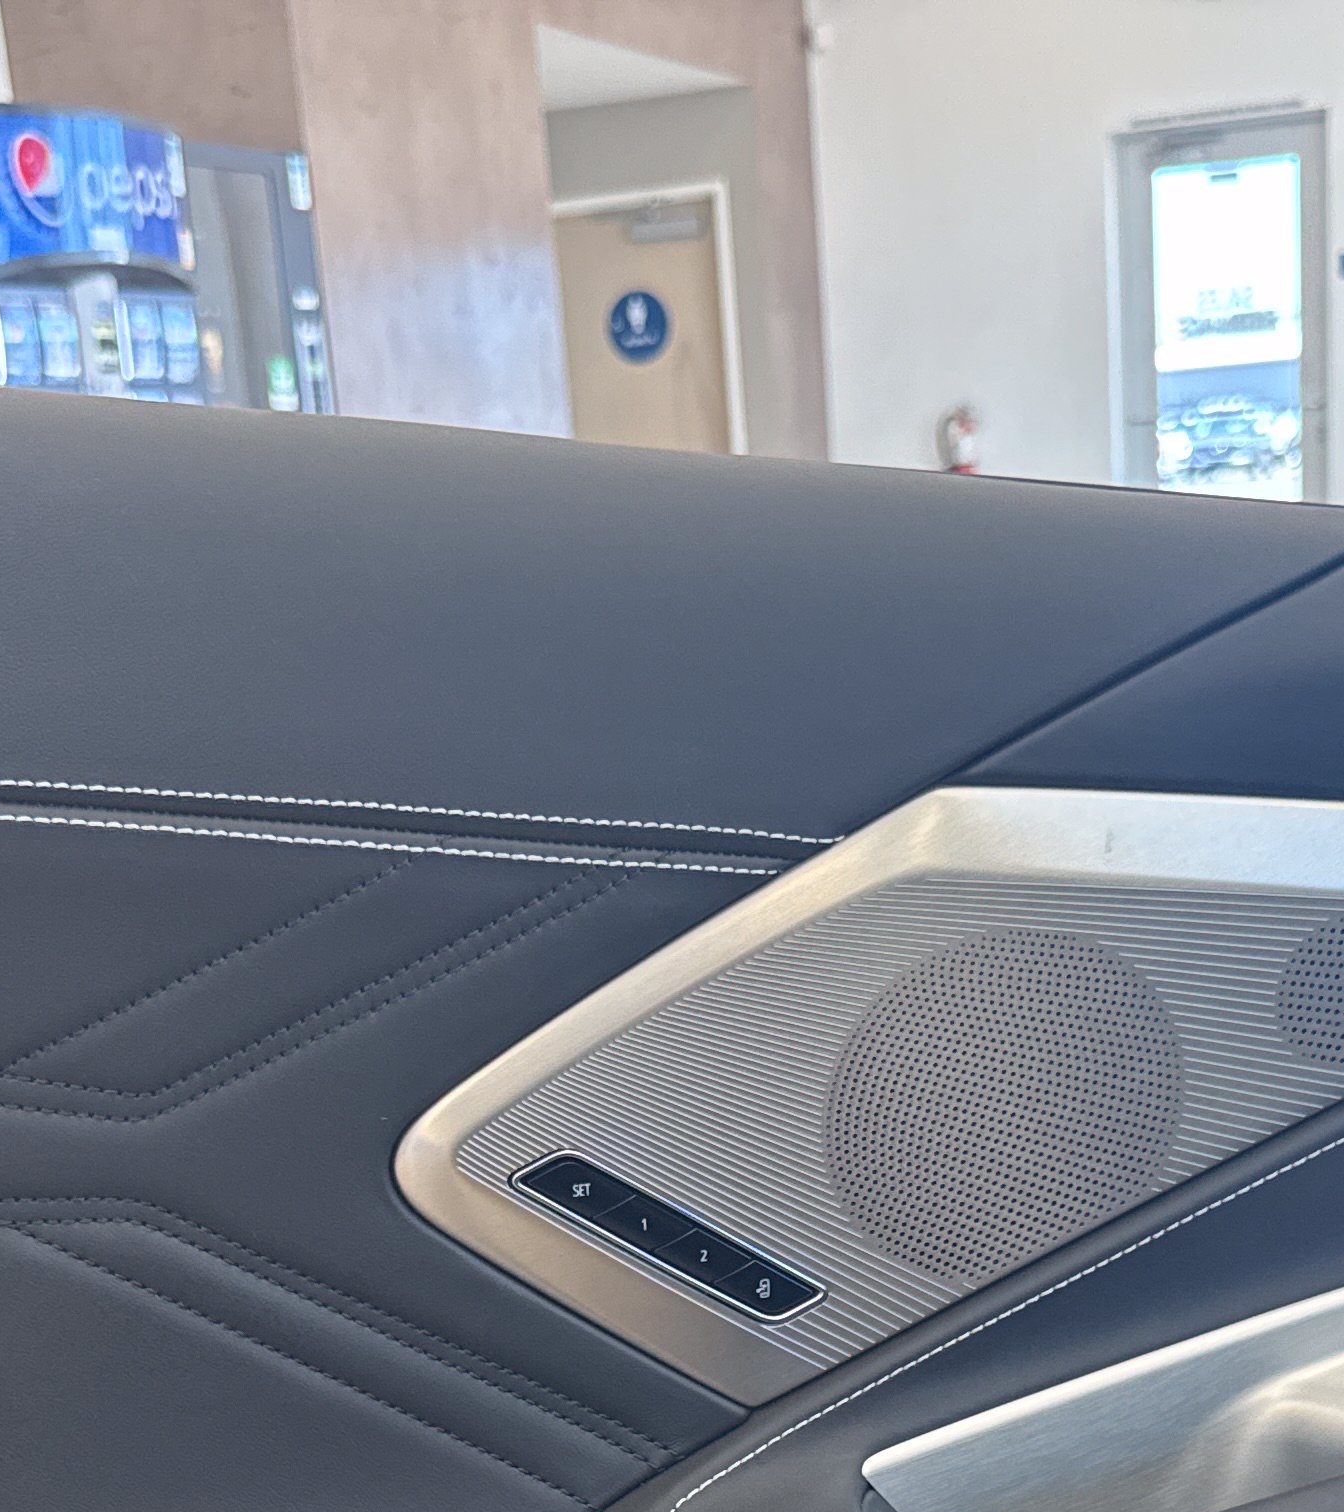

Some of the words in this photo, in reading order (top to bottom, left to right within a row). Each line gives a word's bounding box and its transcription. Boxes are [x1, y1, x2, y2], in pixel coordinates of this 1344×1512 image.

[572, 1183, 591, 1198] SET
[641, 1218, 648, 1231] 1
[700, 1250, 708, 1262] 2
